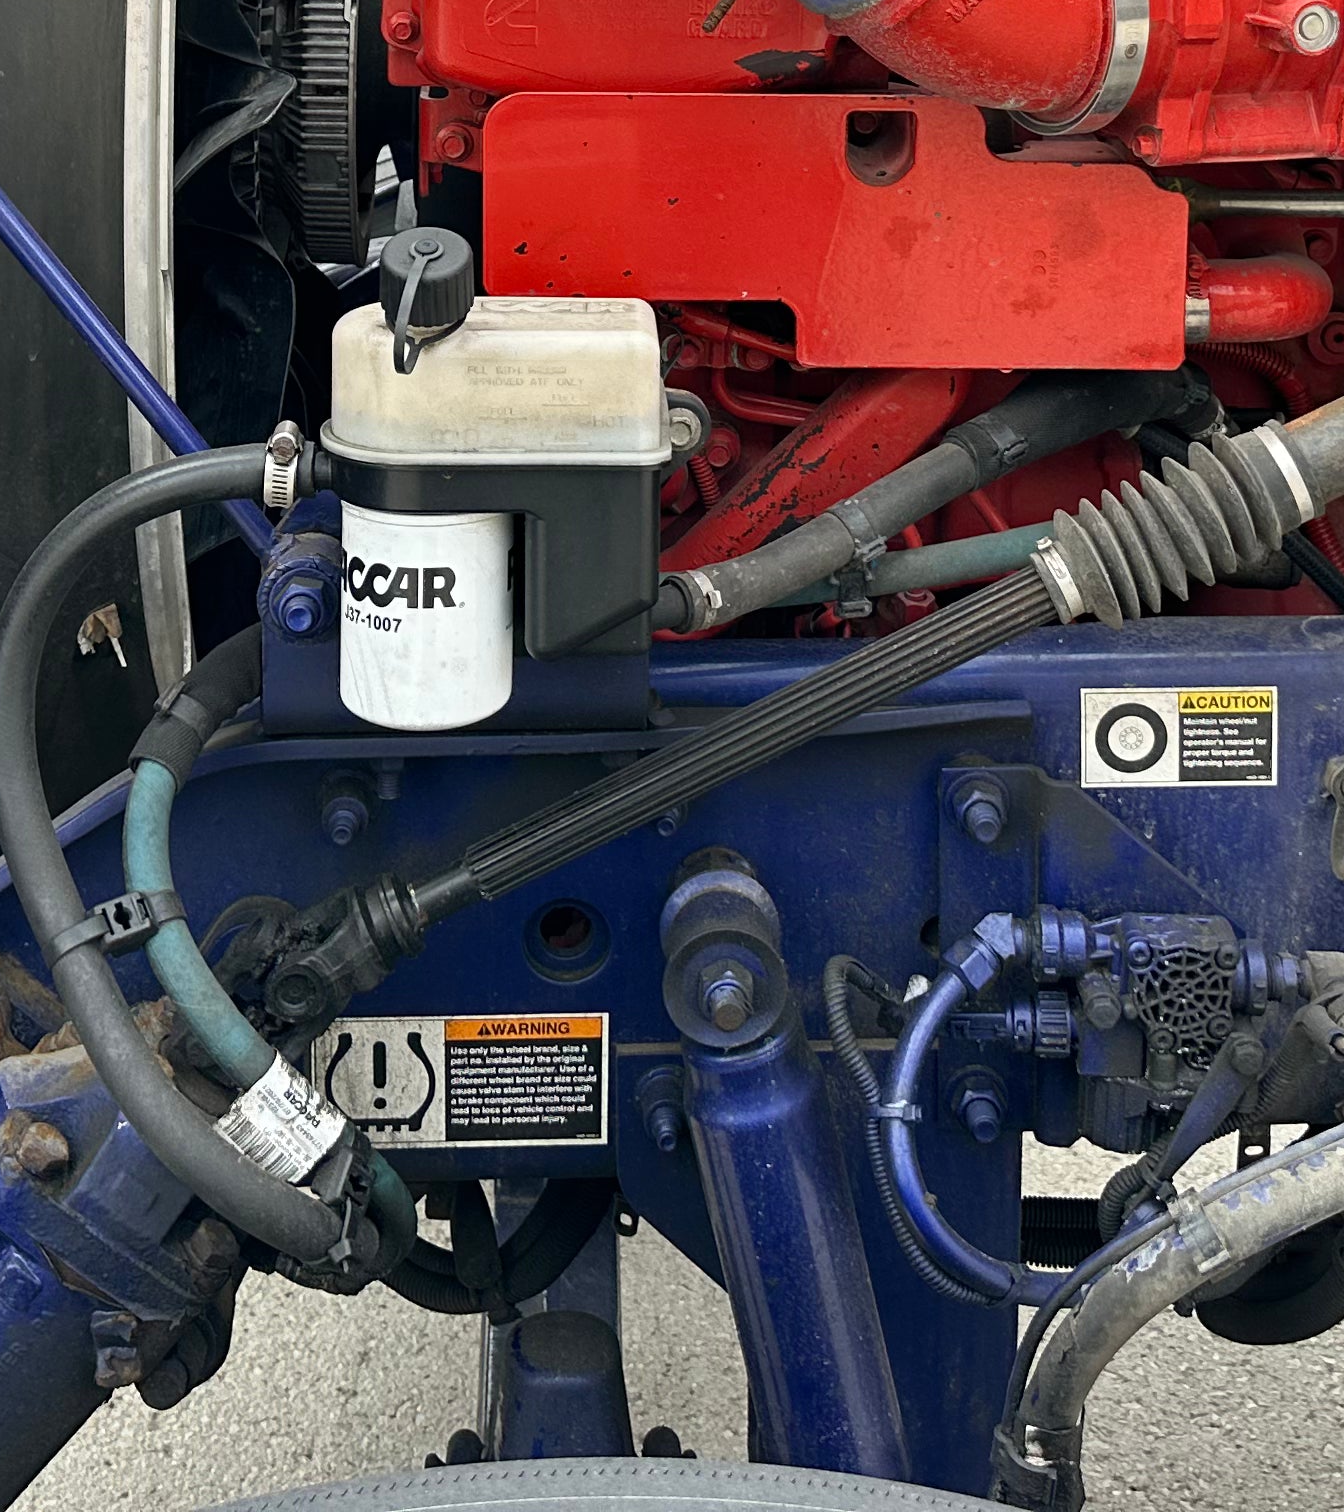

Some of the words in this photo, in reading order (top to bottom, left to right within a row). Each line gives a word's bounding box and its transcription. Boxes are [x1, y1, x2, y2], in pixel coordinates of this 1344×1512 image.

[342, 550, 457, 609] CCAR
[1197, 696, 1270, 709] CAUTION
[1223, 727, 1239, 735] See
[1255, 738, 1267, 746] for
[1182, 749, 1210, 758] proper
[1238, 748, 1254, 756] and
[492, 1022, 570, 1035] WARNING
[470, 1046, 488, 1055] only
[490, 1046, 504, 1054] the
[562, 1045, 579, 1053] size
[451, 1057, 468, 1065] part
[486, 1056, 522, 1064] installed
[524, 1056, 535, 1065] by
[537, 1055, 551, 1063] the
[553, 1055, 585, 1064] original
[451, 1067, 496, 1076] equipment
[560, 1065, 576, 1073] Use
[451, 1076, 487, 1085] different
[489, 1076, 514, 1084] wheel
[479, 1086, 502, 1094] valve
[503, 1086, 524, 1094] stem
[537, 1085, 573, 1093] interfere
[458, 1097, 483, 1105] brake
[484, 1097, 533, 1105] component
[534, 1095, 559, 1103] which
[284, 1088, 320, 1128] PACCAR
[482, 1106, 500, 1114] loss
[513, 1105, 543, 1113] vehicle
[545, 1105, 576, 1113] control
[577, 1104, 594, 1112] and
[451, 1117, 470, 1126] may
[502, 1116, 540, 1125] personal
